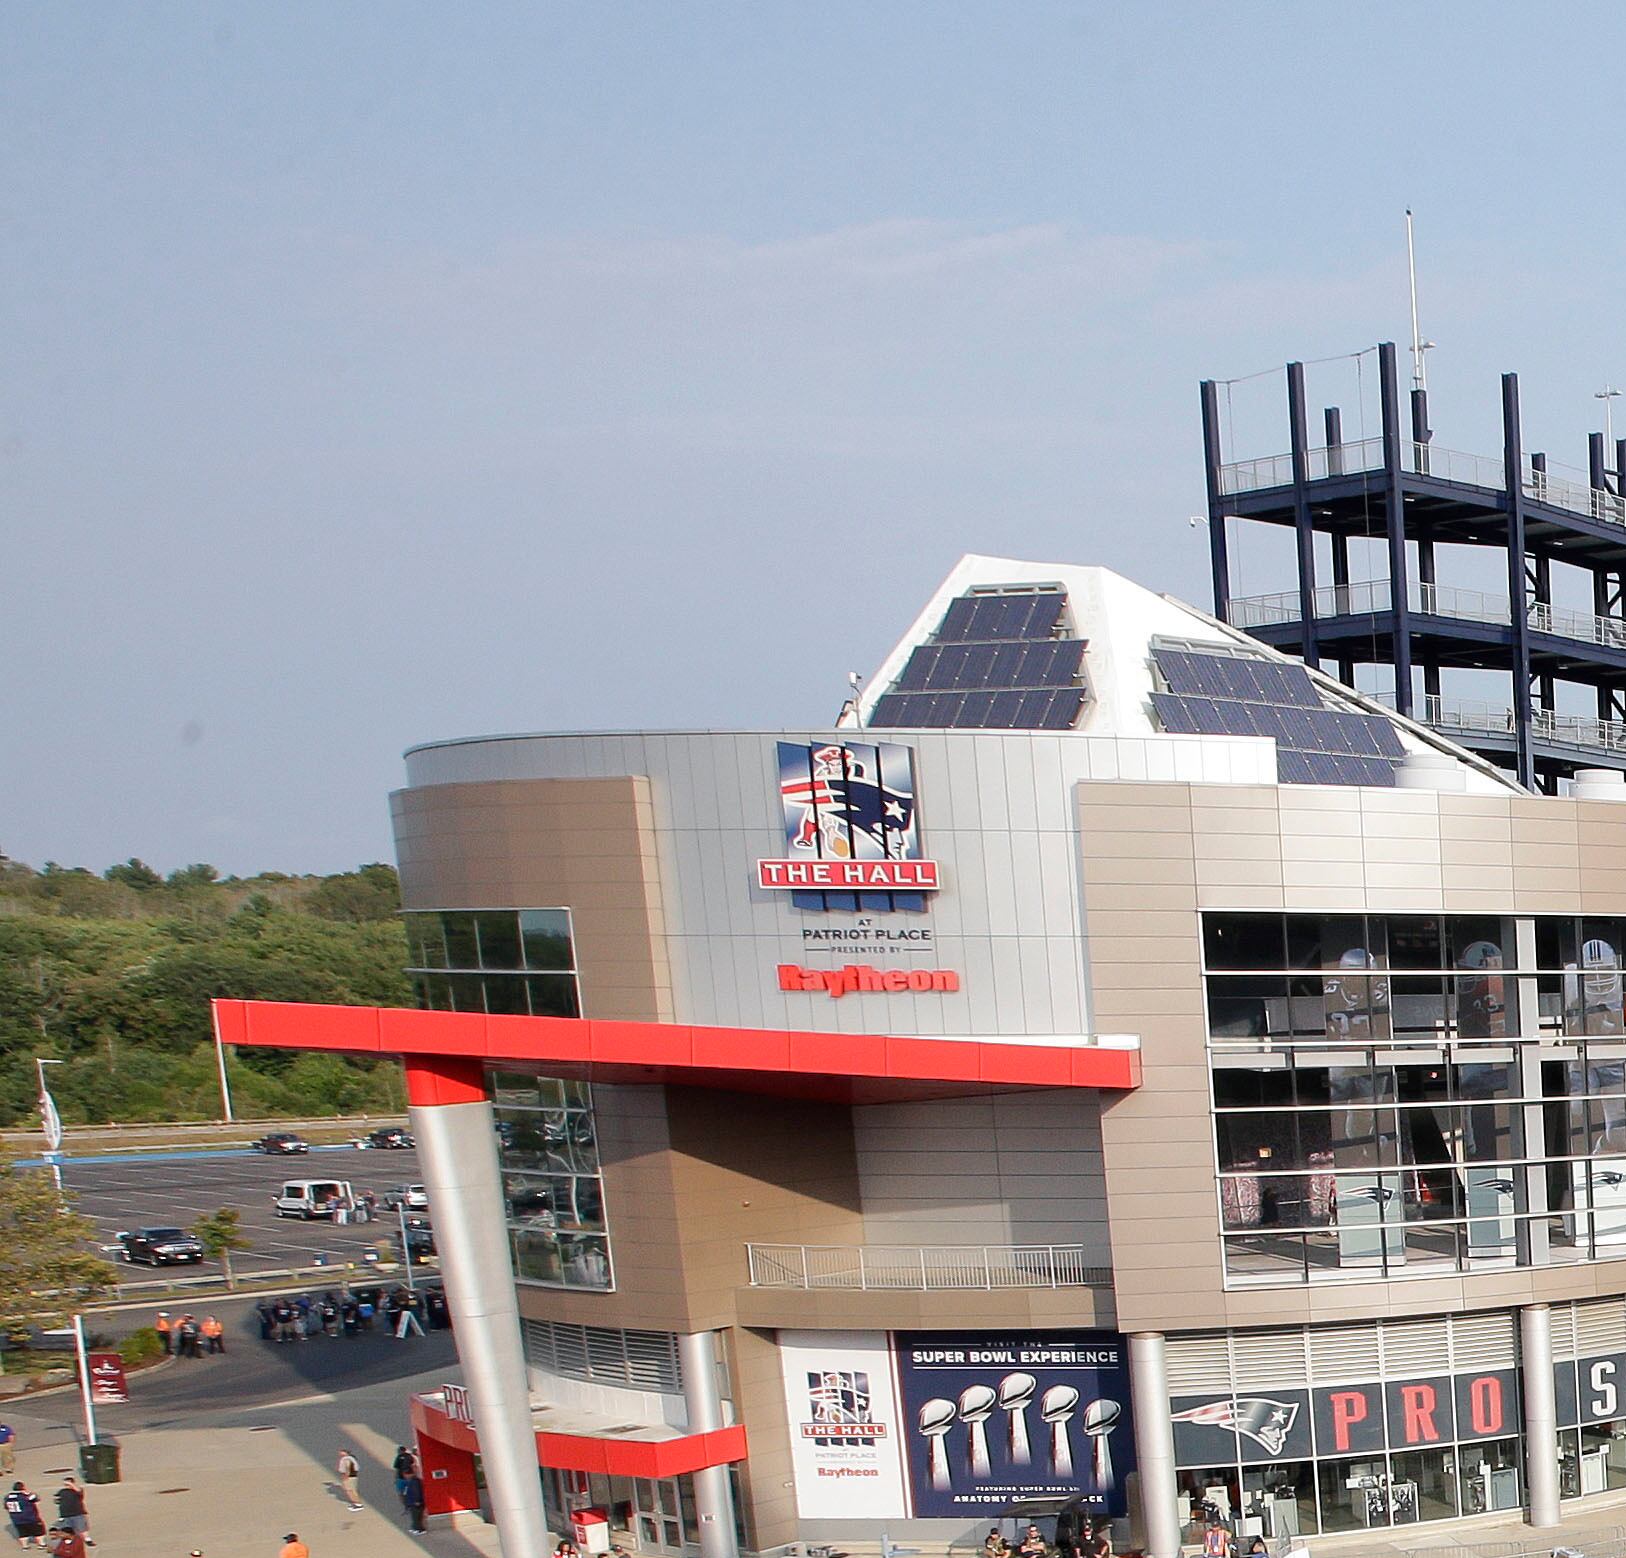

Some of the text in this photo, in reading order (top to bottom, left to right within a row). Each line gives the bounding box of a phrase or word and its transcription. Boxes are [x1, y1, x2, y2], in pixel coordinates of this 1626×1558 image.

[764, 864, 934, 884] THE HALL
[858, 918, 872, 926] AT
[803, 929, 932, 941] PATRIOT PLACE
[831, 946, 885, 954] PRESENTED
[776, 964, 960, 998] Raytheon
[912, 1351, 1118, 1363] SUPER BOWL EXPERIENCE
[1331, 1376, 1504, 1452] PRO
[805, 1426, 884, 1434] THE HALL
[817, 1468, 879, 1478] Raytheon
